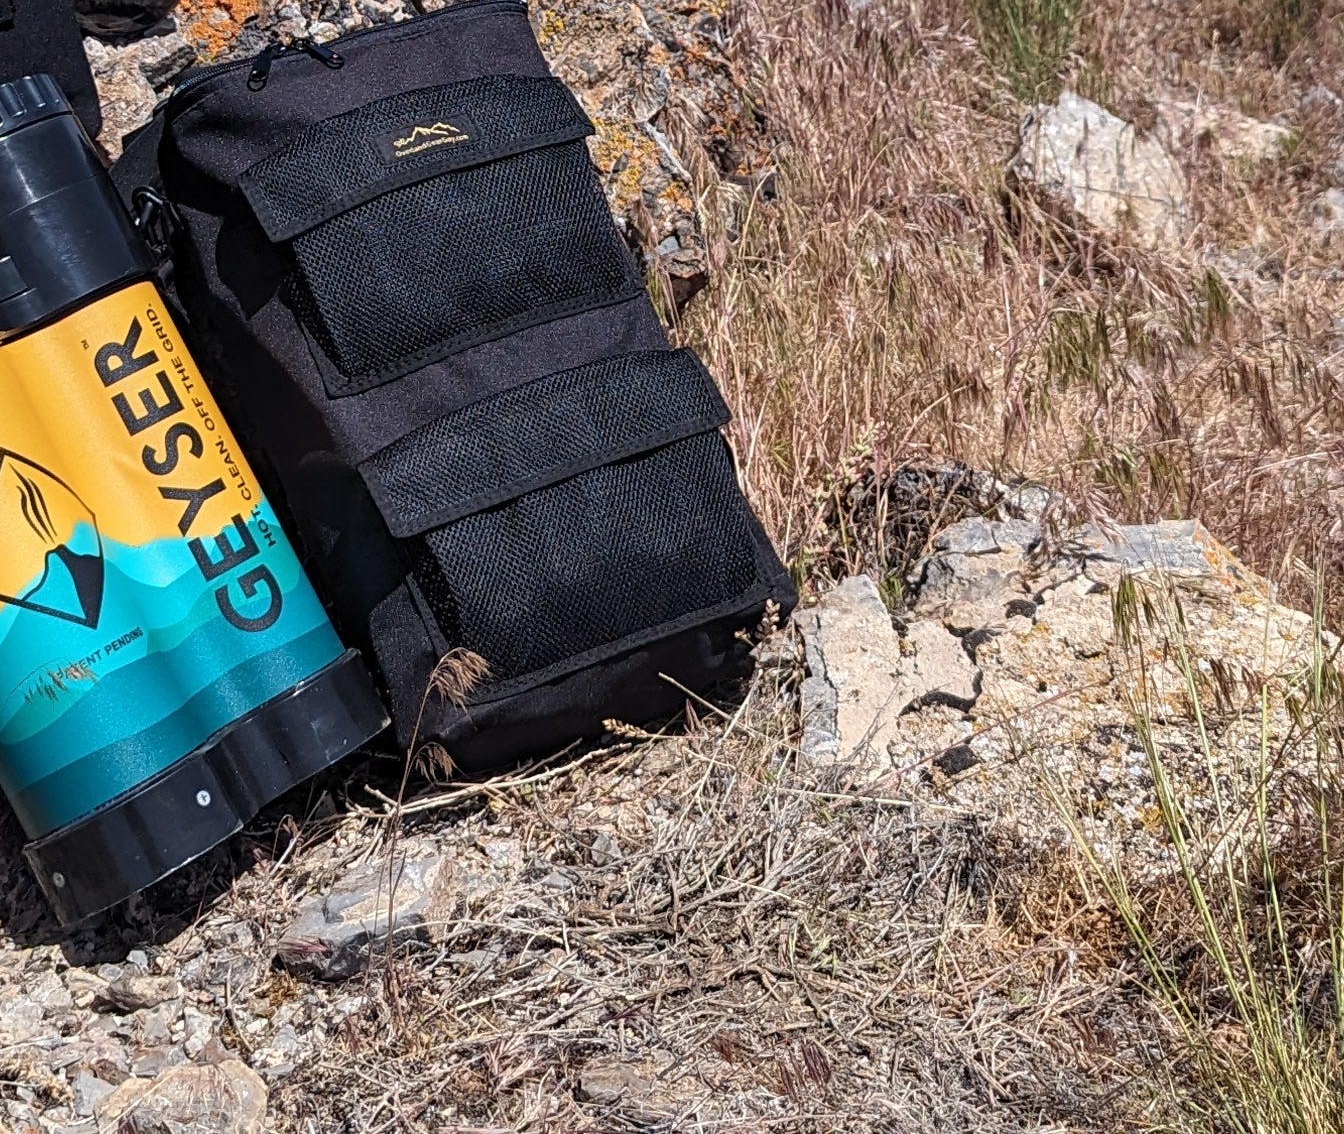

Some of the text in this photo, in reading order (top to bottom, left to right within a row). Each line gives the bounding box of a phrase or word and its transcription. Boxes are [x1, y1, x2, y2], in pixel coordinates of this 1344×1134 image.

[94, 315, 283, 633] GEYSER
[146, 303, 276, 548] HOT. CLEAN. OFF THE GRID.
[104, 626, 144, 656] PENDING
